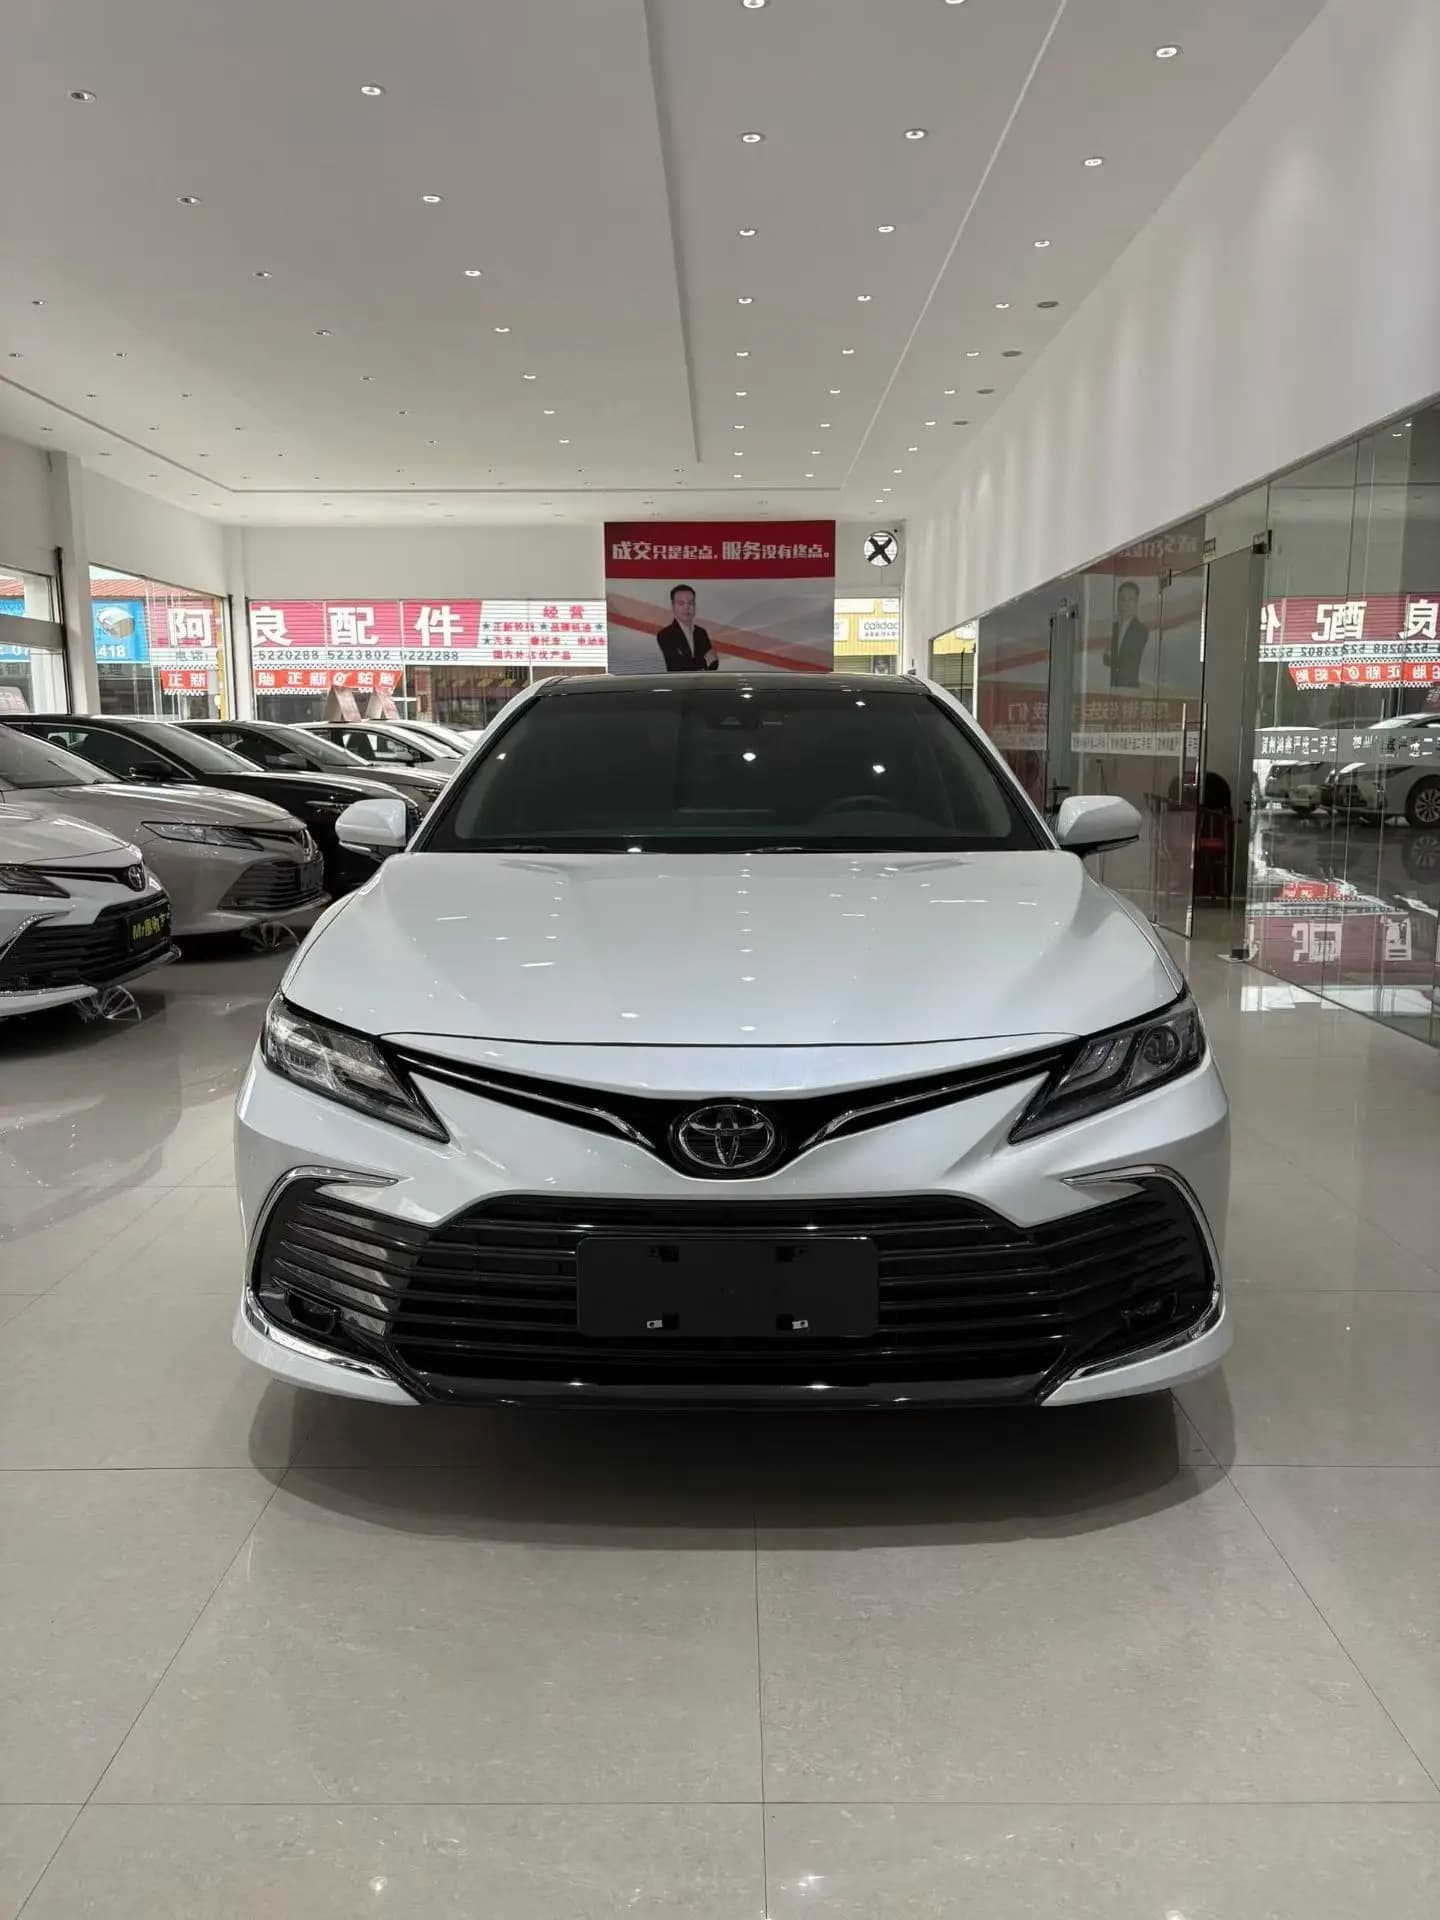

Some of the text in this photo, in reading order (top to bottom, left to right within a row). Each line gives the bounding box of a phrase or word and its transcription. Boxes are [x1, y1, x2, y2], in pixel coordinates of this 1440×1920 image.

[543, 605, 584, 619] 经营
[328, 650, 391, 661] 5223802
[287, 672, 327, 685] 正新
